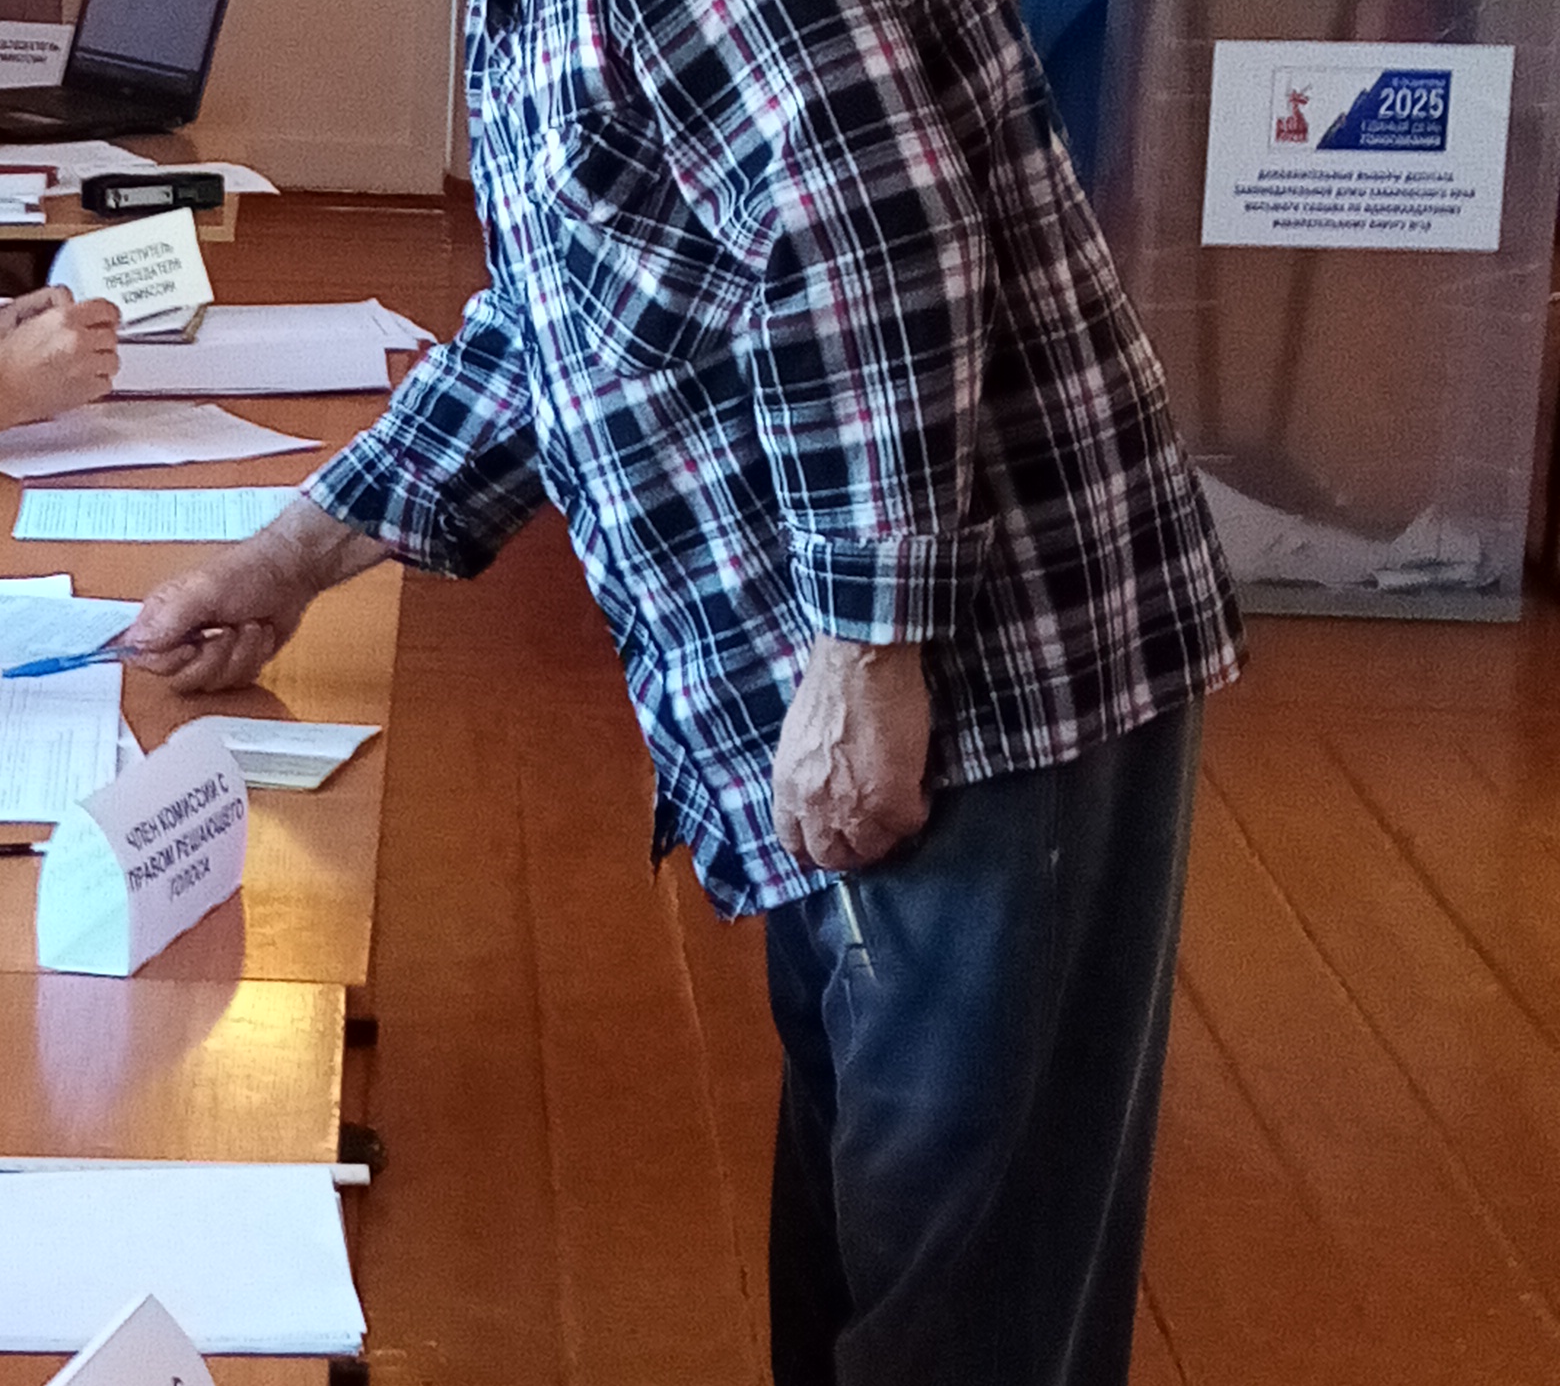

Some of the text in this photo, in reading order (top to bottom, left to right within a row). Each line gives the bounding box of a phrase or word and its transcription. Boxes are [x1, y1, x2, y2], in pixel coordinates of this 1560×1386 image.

[1378, 87, 1444, 120] 2025
[126, 772, 229, 852] ЧЛЕН КОМИССИИ С
[128, 797, 245, 892] ПРАВОМ РЕШАЮЩЕГО
